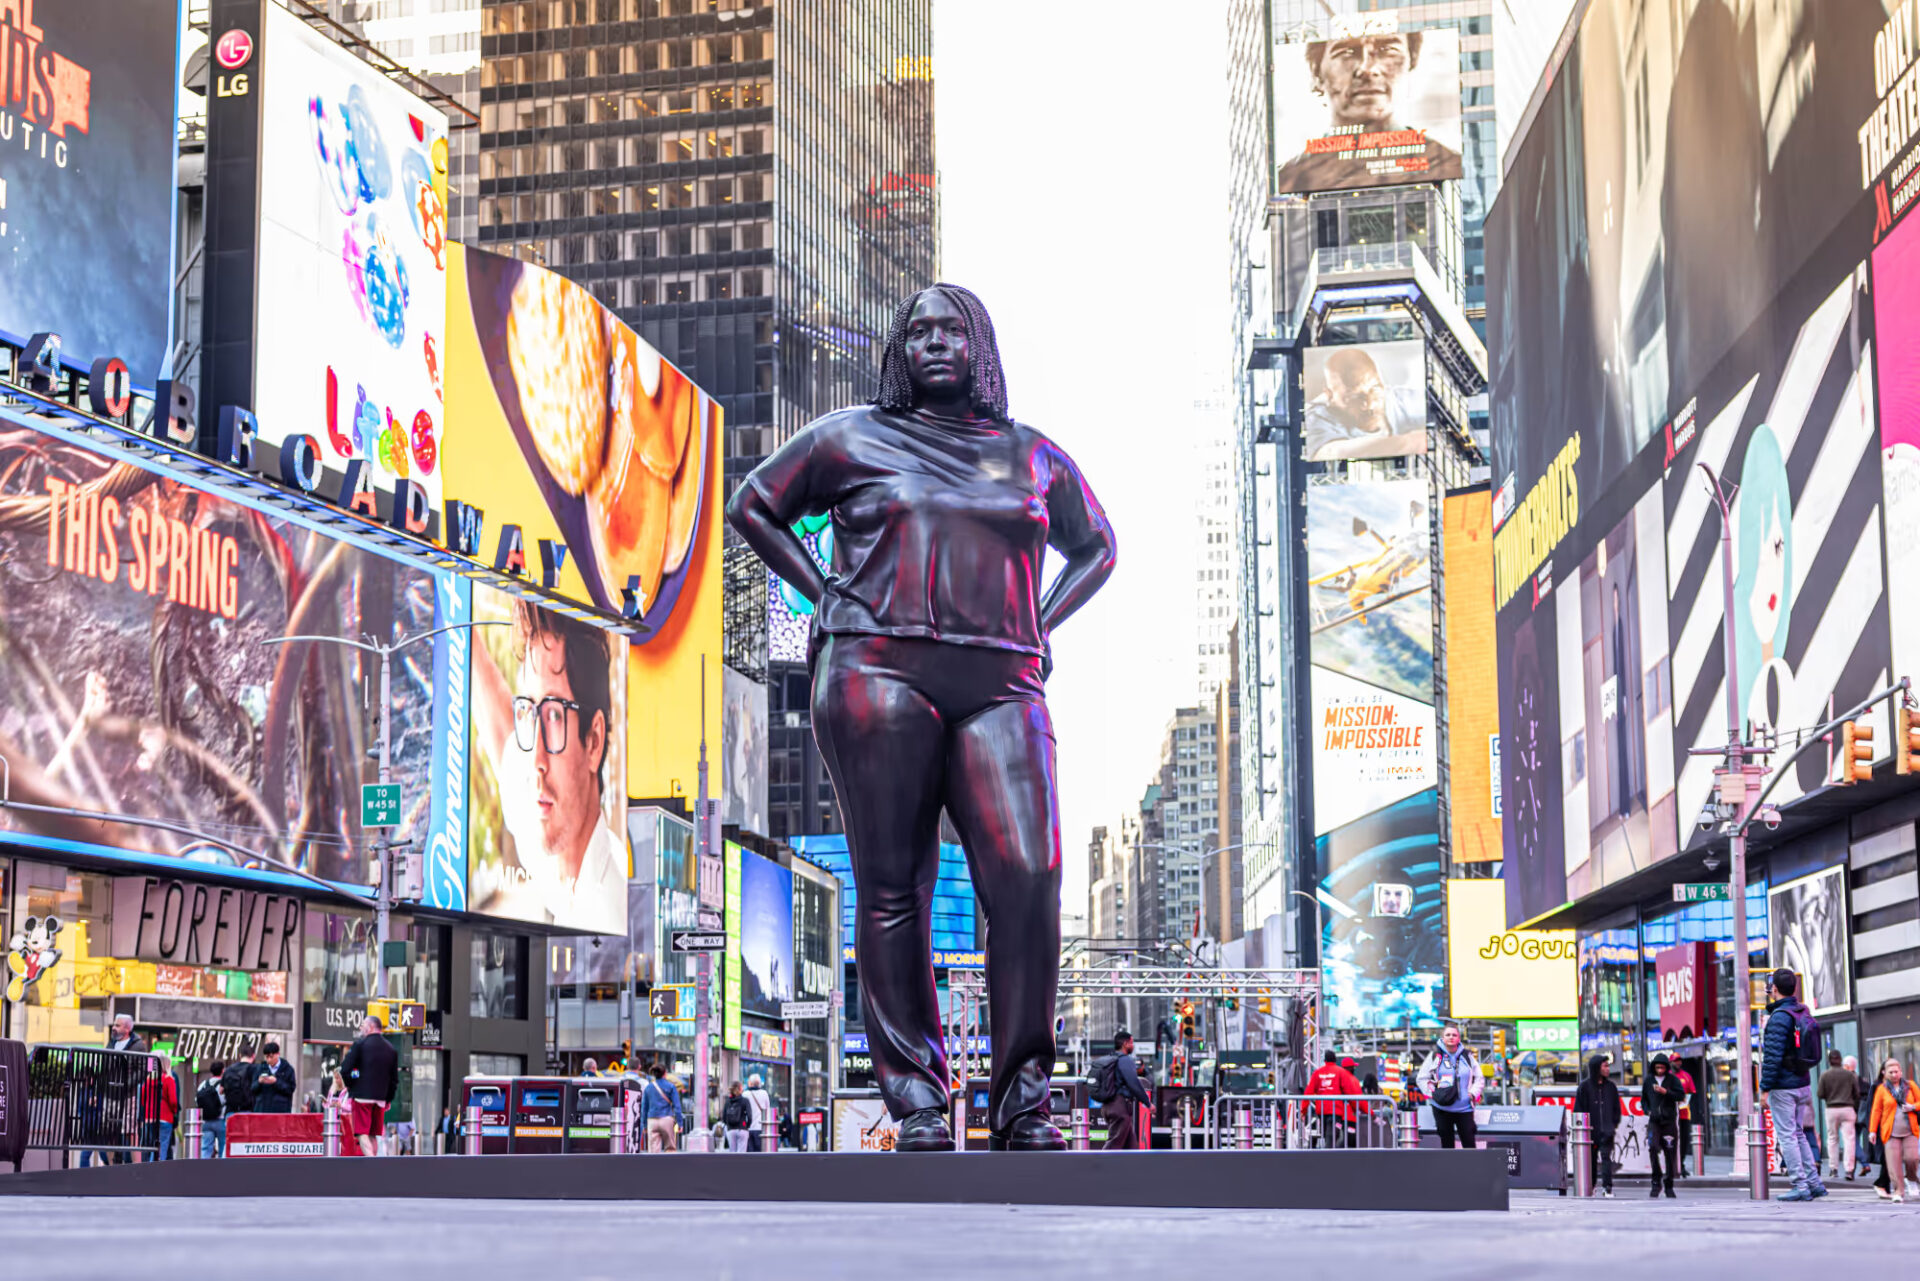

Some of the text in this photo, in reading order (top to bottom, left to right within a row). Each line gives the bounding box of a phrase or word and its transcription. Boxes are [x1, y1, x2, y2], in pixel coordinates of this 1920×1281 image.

[217, 73, 249, 97] LG
[1857, 58, 1920, 190] THEATE
[1357, 129, 1427, 149] IMPOSSIBLE
[44, 475, 240, 619] THIS SPRING
[1324, 704, 1398, 728] MISSION:
[1324, 726, 1423, 751] IMPOSSIBLE
[376, 788, 388, 798] TO
[375, 800, 386, 809] 45
[1687, 886, 1698, 900] W
[1703, 886, 1717, 900] 46
[135, 878, 301, 973] FOREVER
[680, 936, 721, 946] ONE WAY
[176, 1028, 244, 1061] FOREVER
[1521, 1028, 1570, 1041] KPOP
[244, 1144, 324, 1154] TIMES SQUARE
